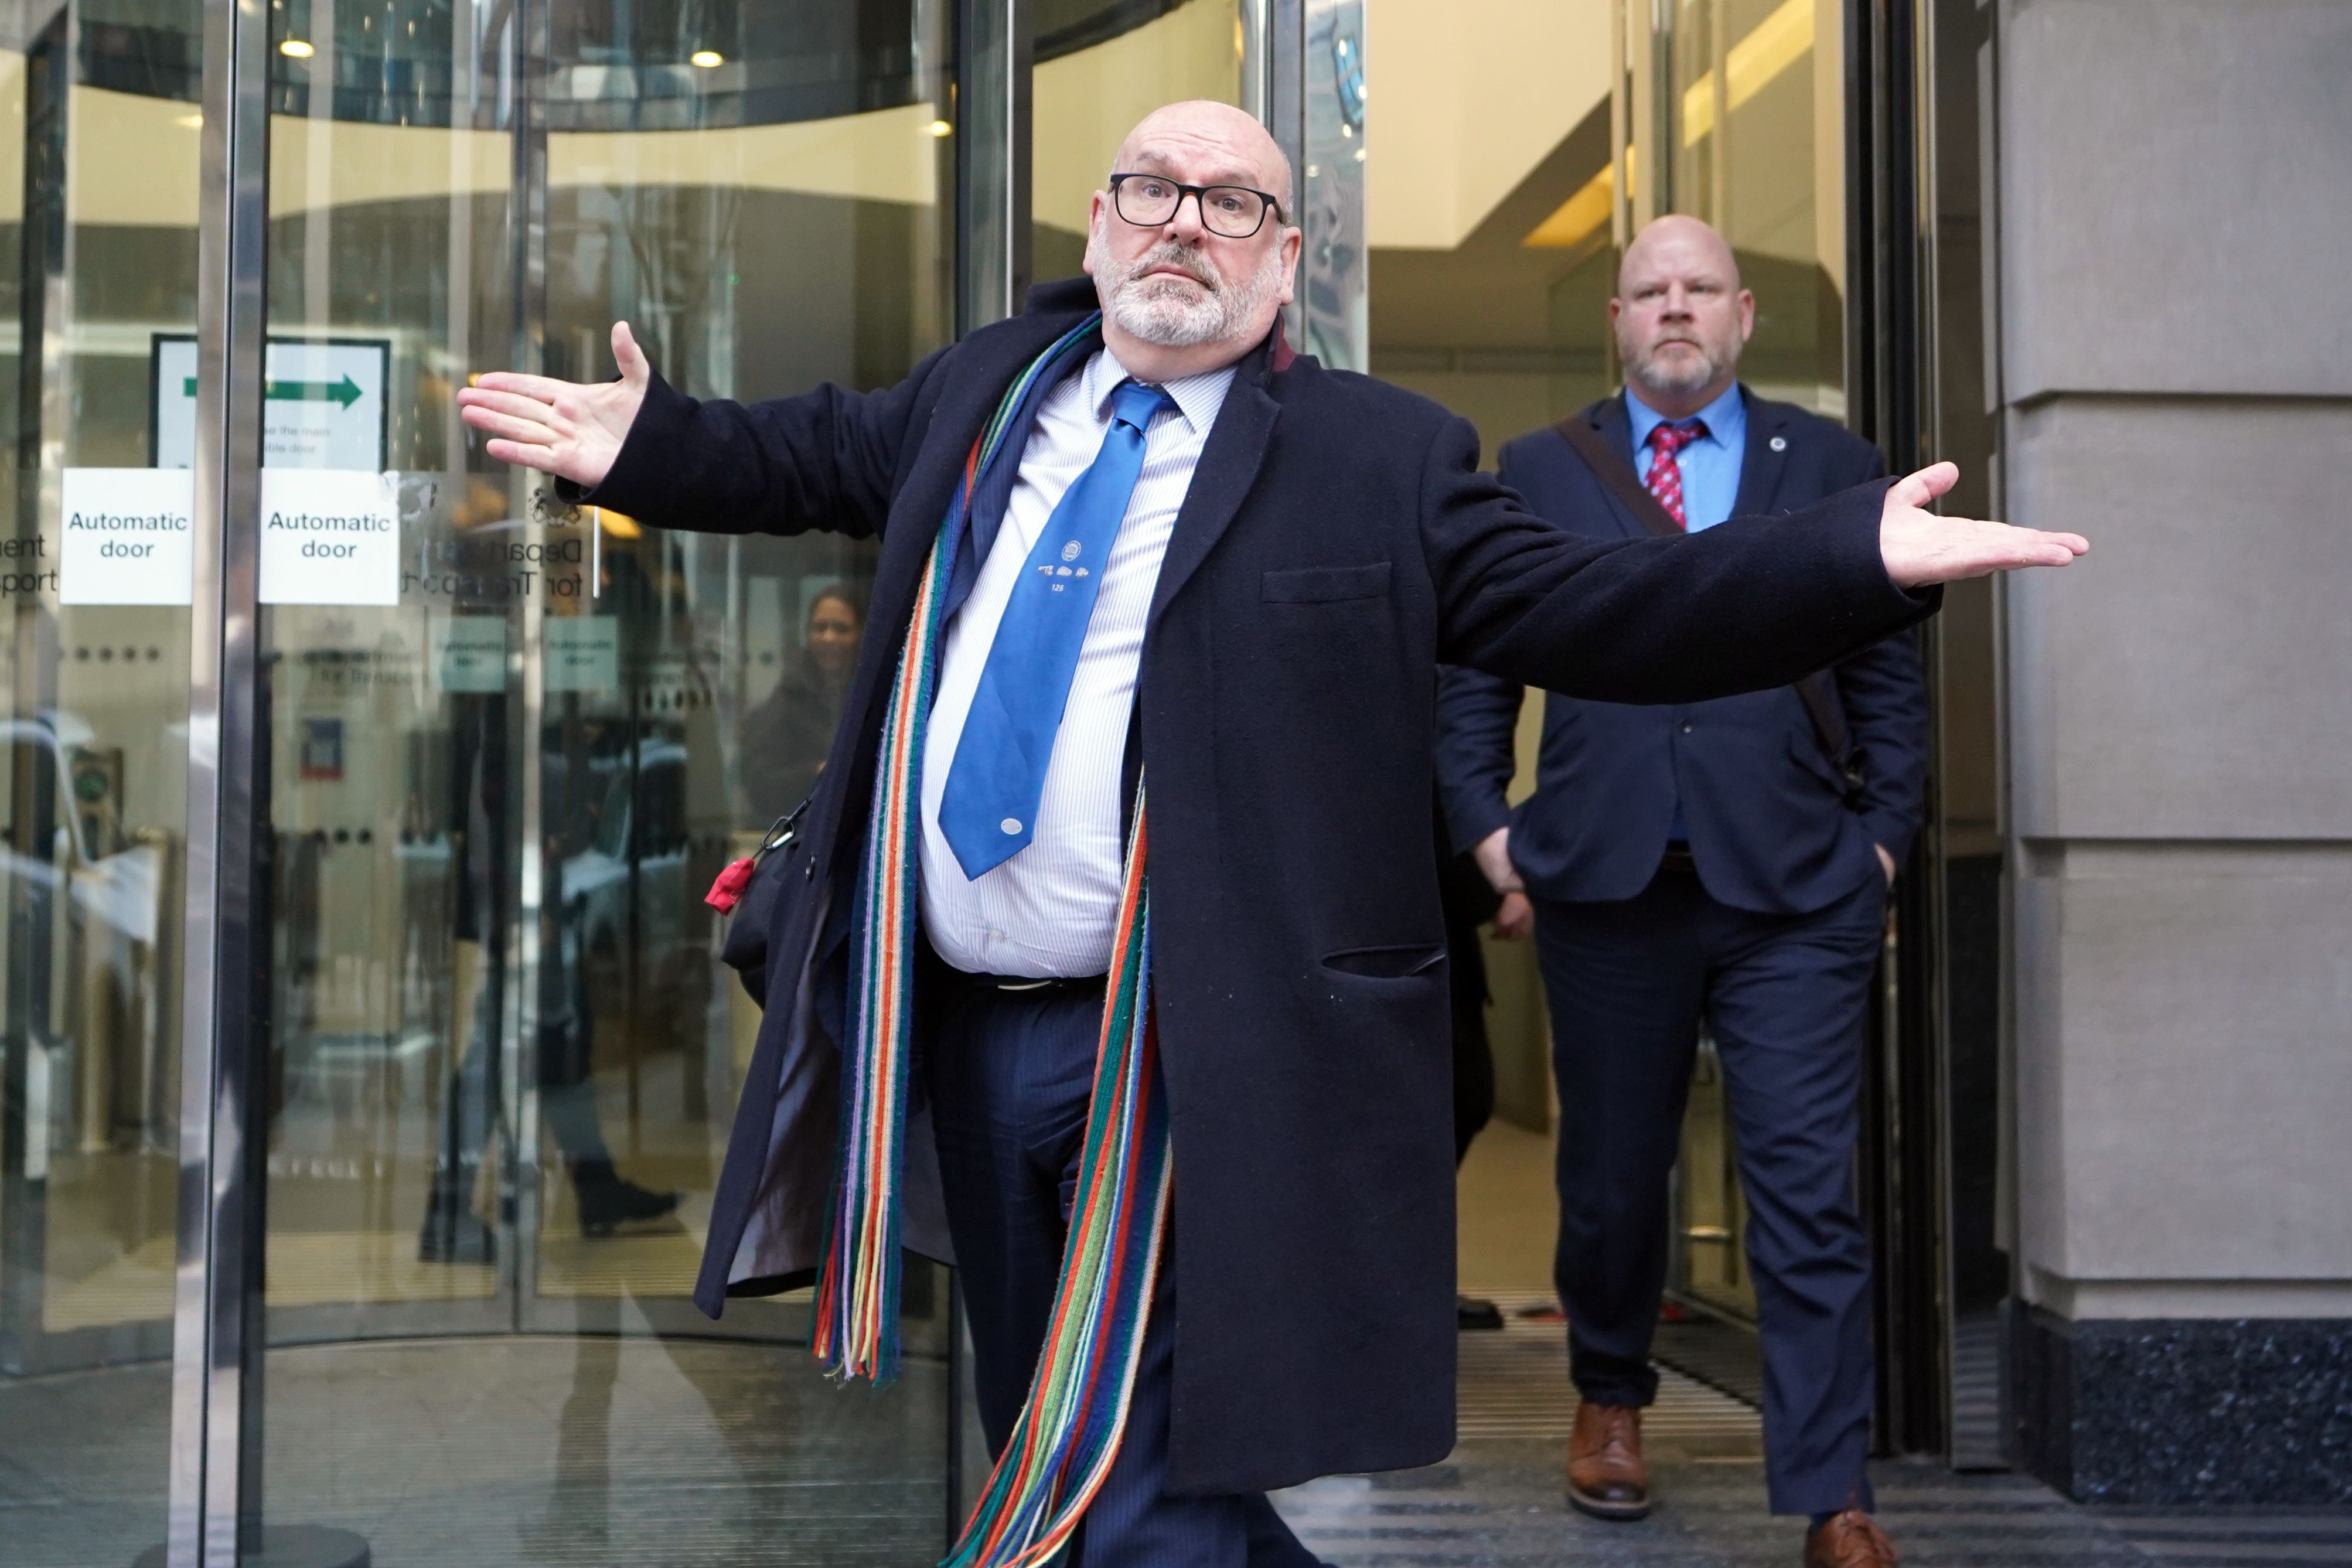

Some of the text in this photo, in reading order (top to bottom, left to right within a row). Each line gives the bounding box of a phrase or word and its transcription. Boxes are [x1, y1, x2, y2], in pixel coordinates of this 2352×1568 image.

[289, 444, 316, 454] door
[69, 512, 188, 531] Automatic
[268, 511, 391, 531] Automatic
[0, 534, 45, 557] ent
[100, 539, 154, 557] door
[301, 539, 357, 558] door
[1052, 584, 1064, 592] 125
